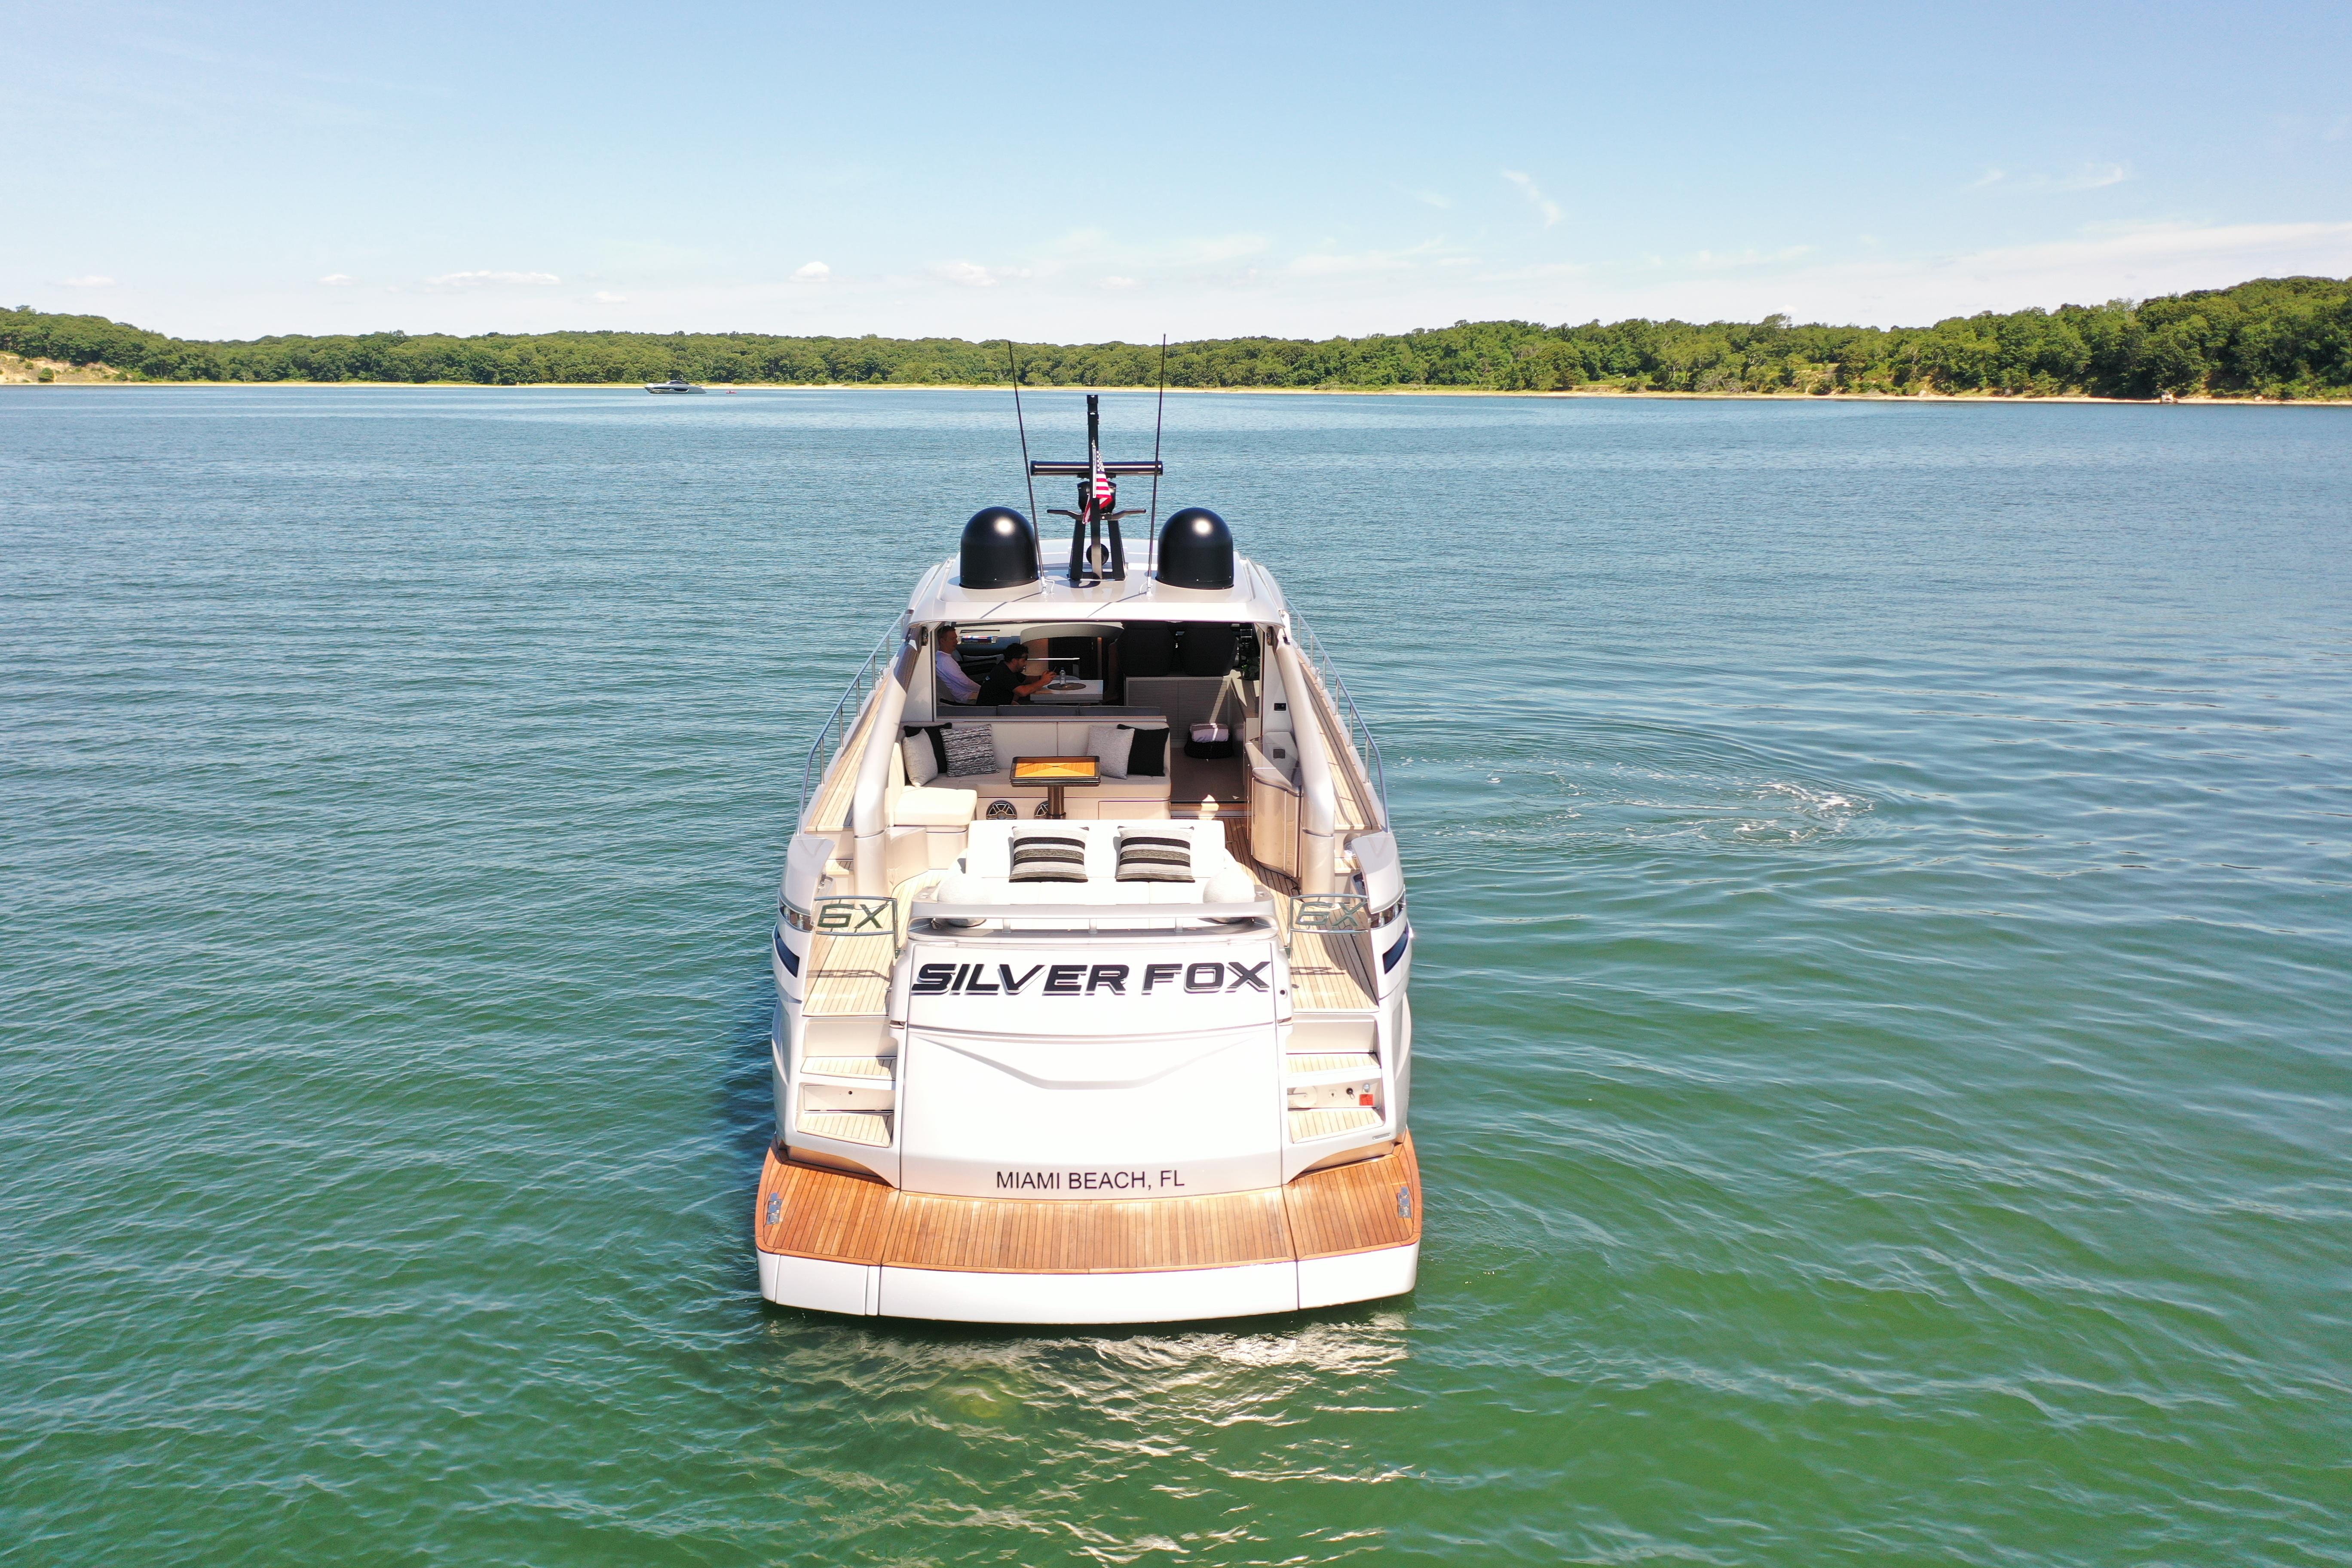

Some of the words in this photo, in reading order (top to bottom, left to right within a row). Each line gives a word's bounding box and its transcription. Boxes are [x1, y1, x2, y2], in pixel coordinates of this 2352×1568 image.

[818, 903, 889, 928] 6X
[911, 963, 1130, 995] SILVER
[1141, 961, 1271, 995] FOX
[996, 1171, 1060, 1189] MIAMI
[1069, 1171, 1152, 1191] BEACH,
[1161, 1170, 1185, 1187] FL
